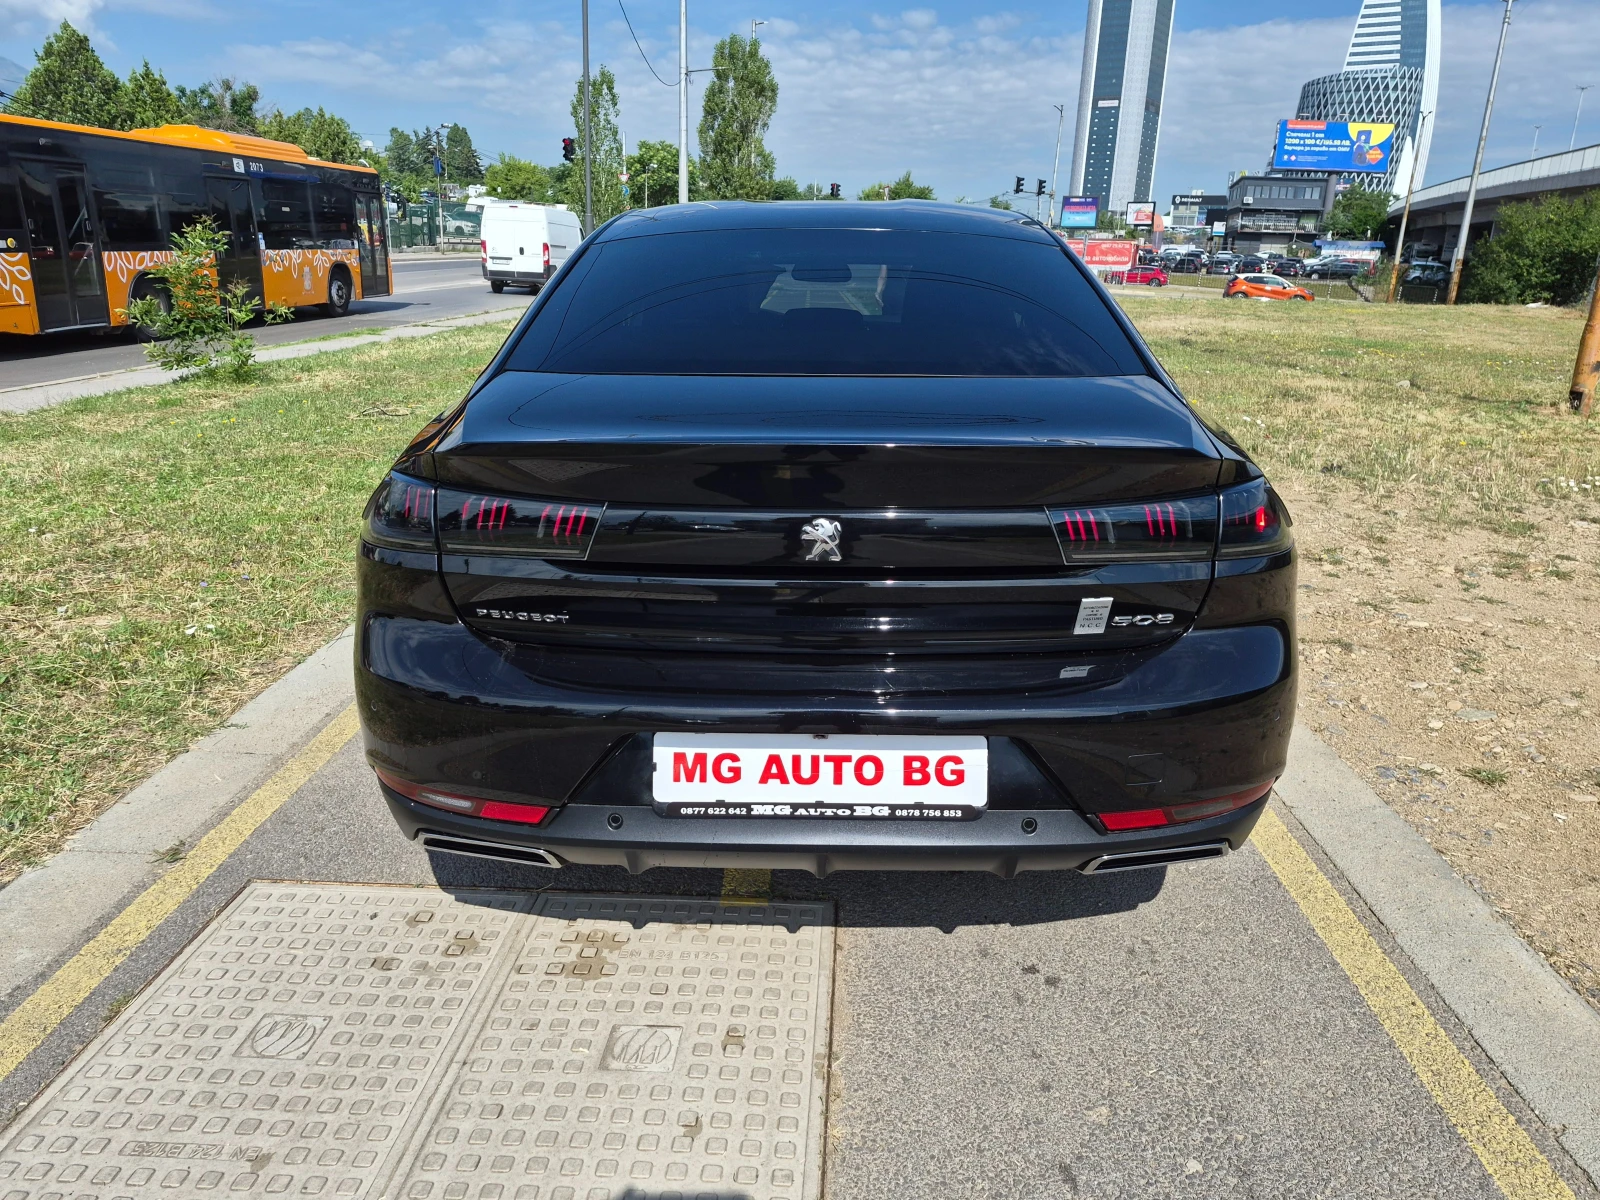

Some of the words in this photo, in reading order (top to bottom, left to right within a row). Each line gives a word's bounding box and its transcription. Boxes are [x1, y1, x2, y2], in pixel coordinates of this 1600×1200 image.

[249, 161, 264, 172] 2073
[476, 608, 569, 623] PEUGEOT
[1111, 613, 1175, 626] 508
[673, 751, 742, 784] MG
[758, 753, 884, 786] AUTO
[903, 755, 965, 787] BG
[680, 807, 706, 815] 0877
[707, 807, 726, 815] 622
[728, 807, 747, 815] 642
[750, 804, 793, 815] MG
[794, 807, 851, 816] AUTO
[852, 805, 891, 816] BG
[895, 808, 921, 817] 0878
[922, 809, 941, 817] 756
[943, 809, 962, 817] 853
[618, 948, 642, 959] EN
[648, 949, 674, 960] 124
[679, 950, 720, 961] B125
[130, 1142, 186, 1157] B125
[189, 1144, 223, 1159] 124
[229, 1146, 262, 1161] EN
